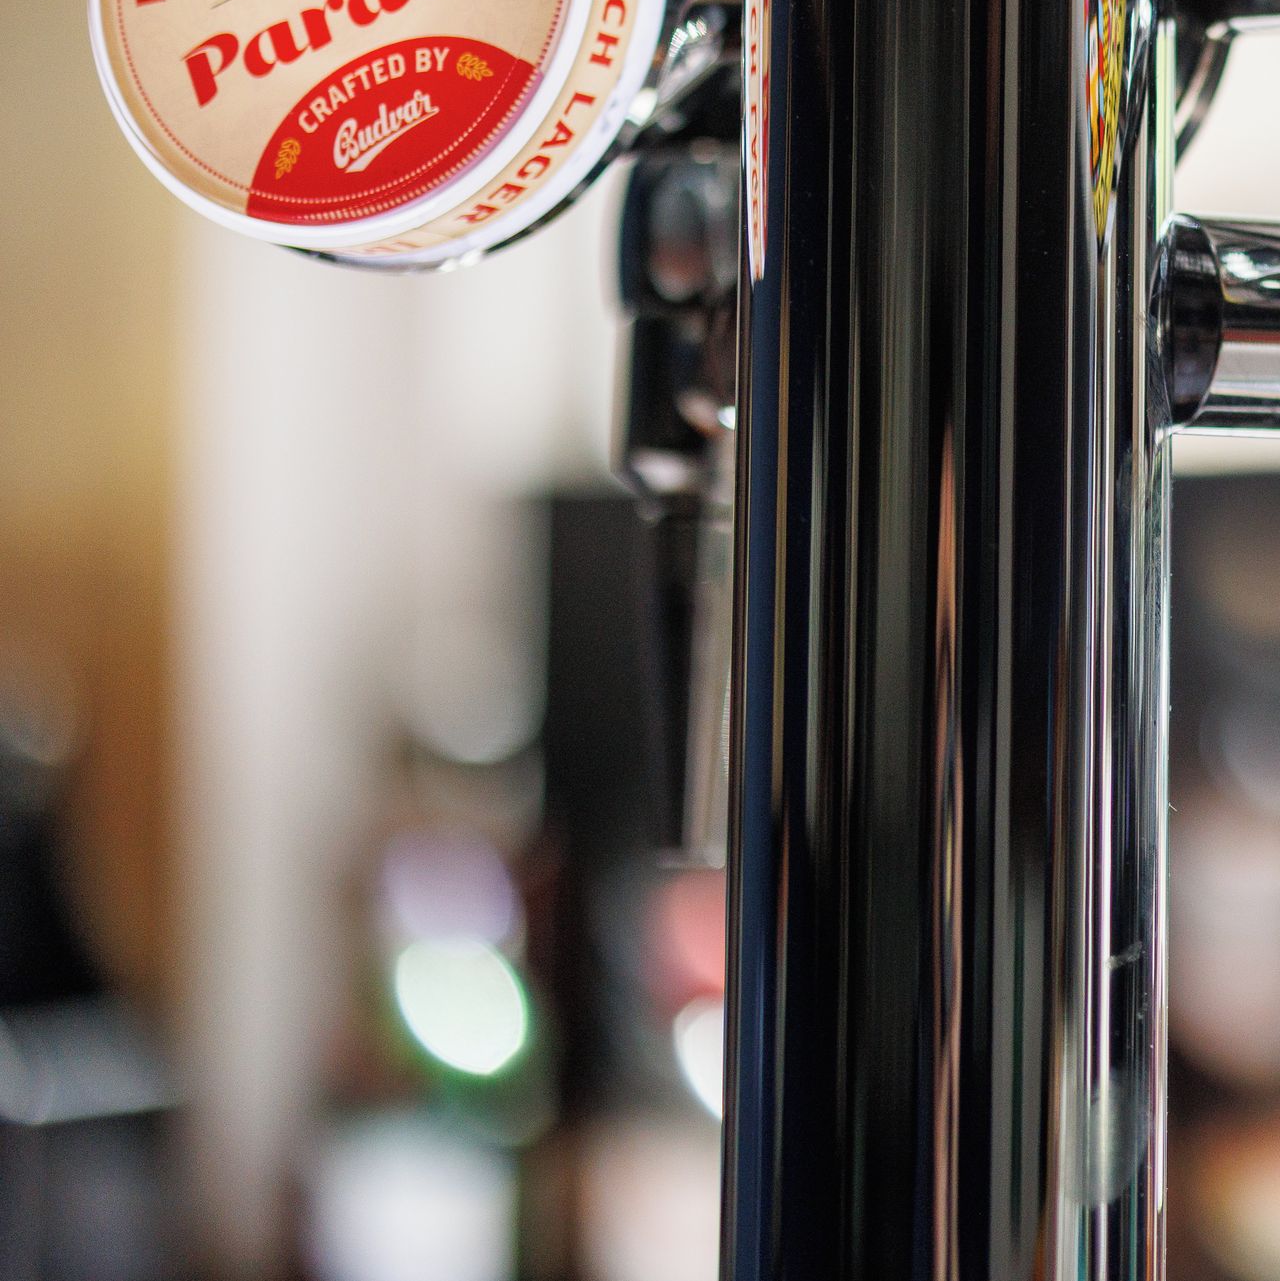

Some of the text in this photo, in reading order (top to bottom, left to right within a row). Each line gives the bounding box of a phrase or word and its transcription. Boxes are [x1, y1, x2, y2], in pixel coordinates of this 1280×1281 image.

[297, 46, 450, 135] CRAFTED BY
[333, 86, 440, 174] Budvar
[457, 89, 594, 227] LAGER
